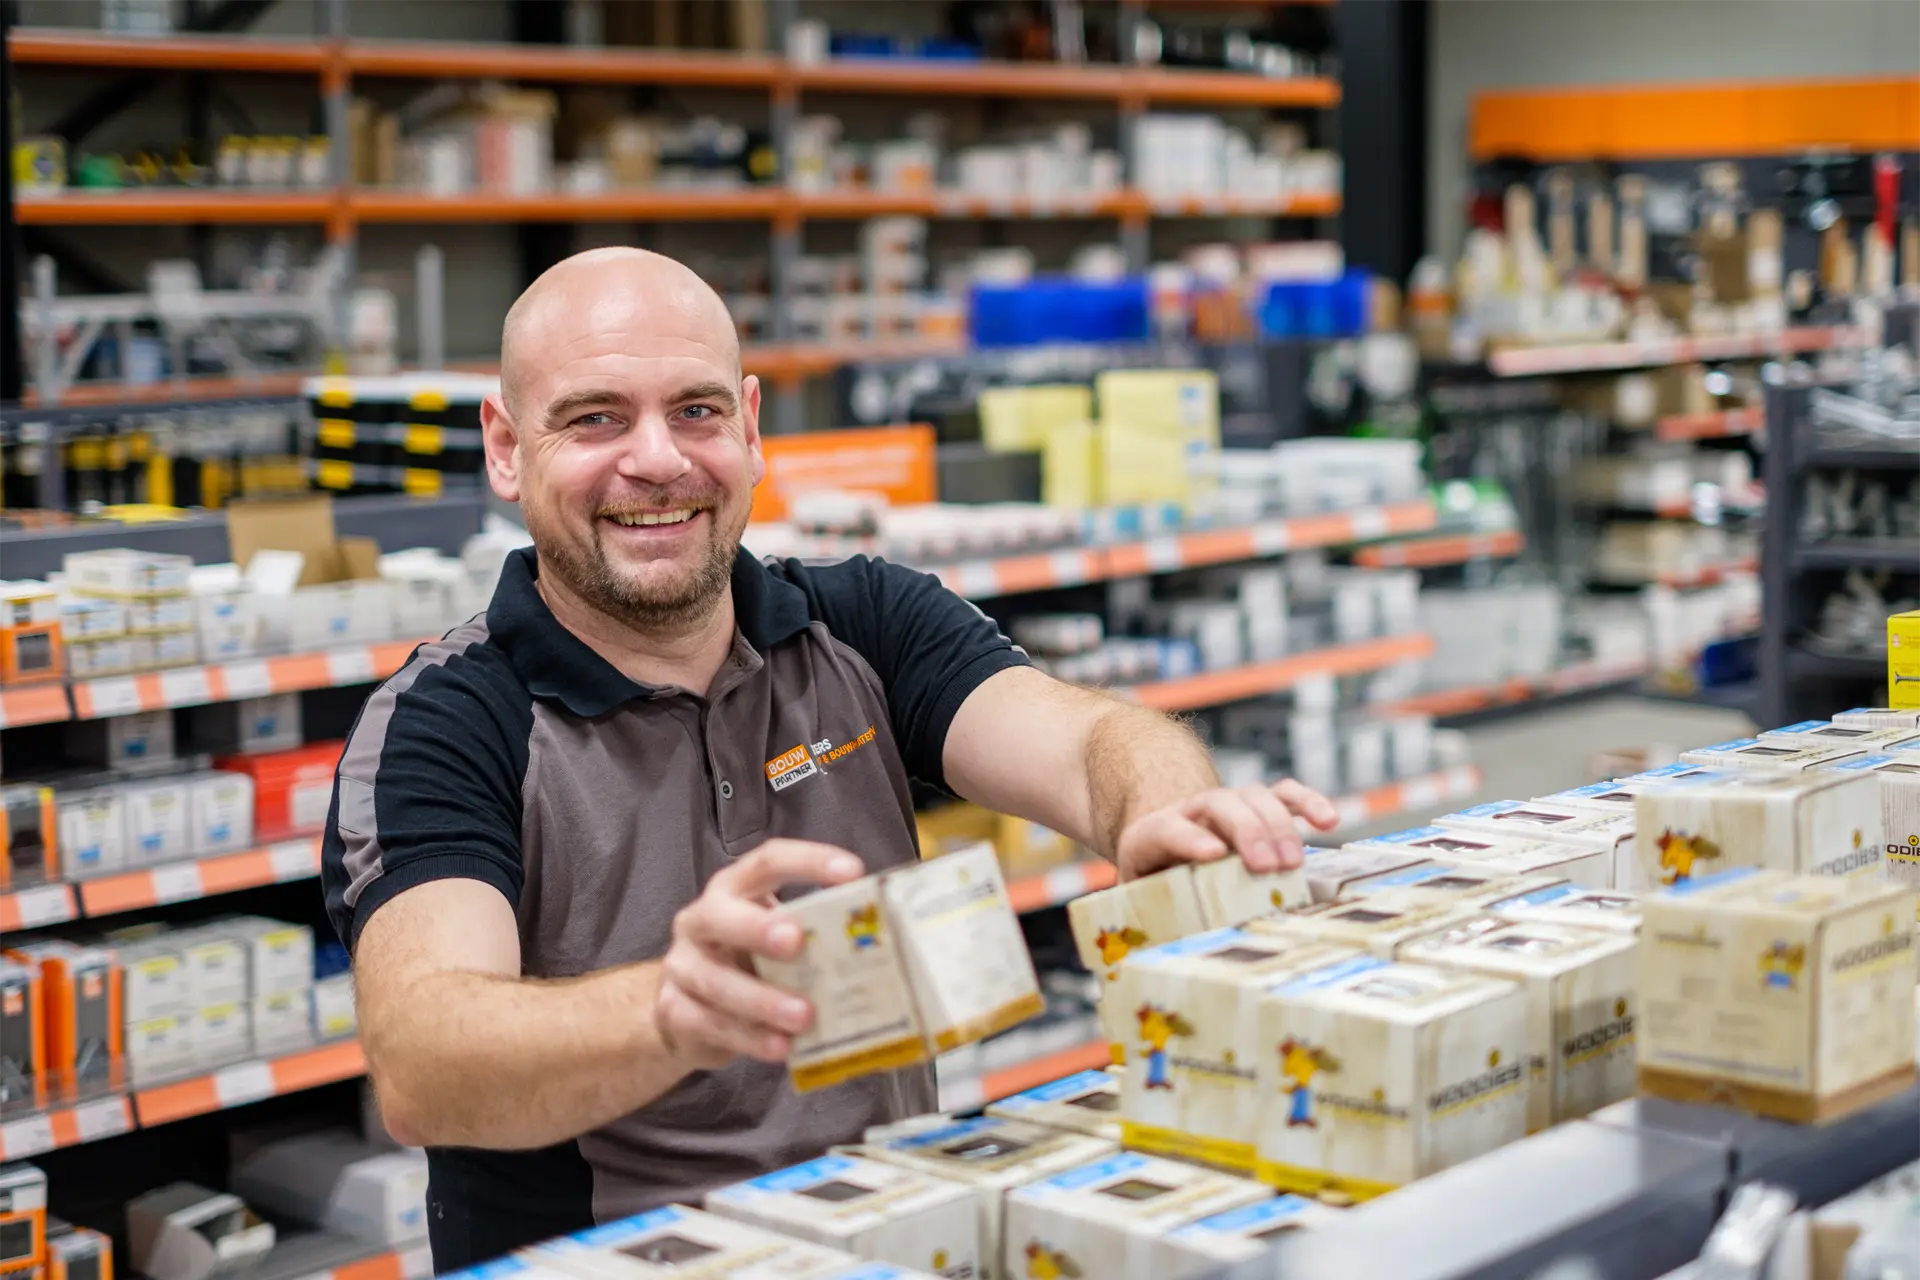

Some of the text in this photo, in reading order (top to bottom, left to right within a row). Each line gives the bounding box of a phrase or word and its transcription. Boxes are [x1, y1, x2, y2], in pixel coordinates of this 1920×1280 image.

[768, 748, 806, 775] BOUW
[774, 762, 813, 788] PARTNER
[1562, 1016, 1635, 1057] WOODIE
